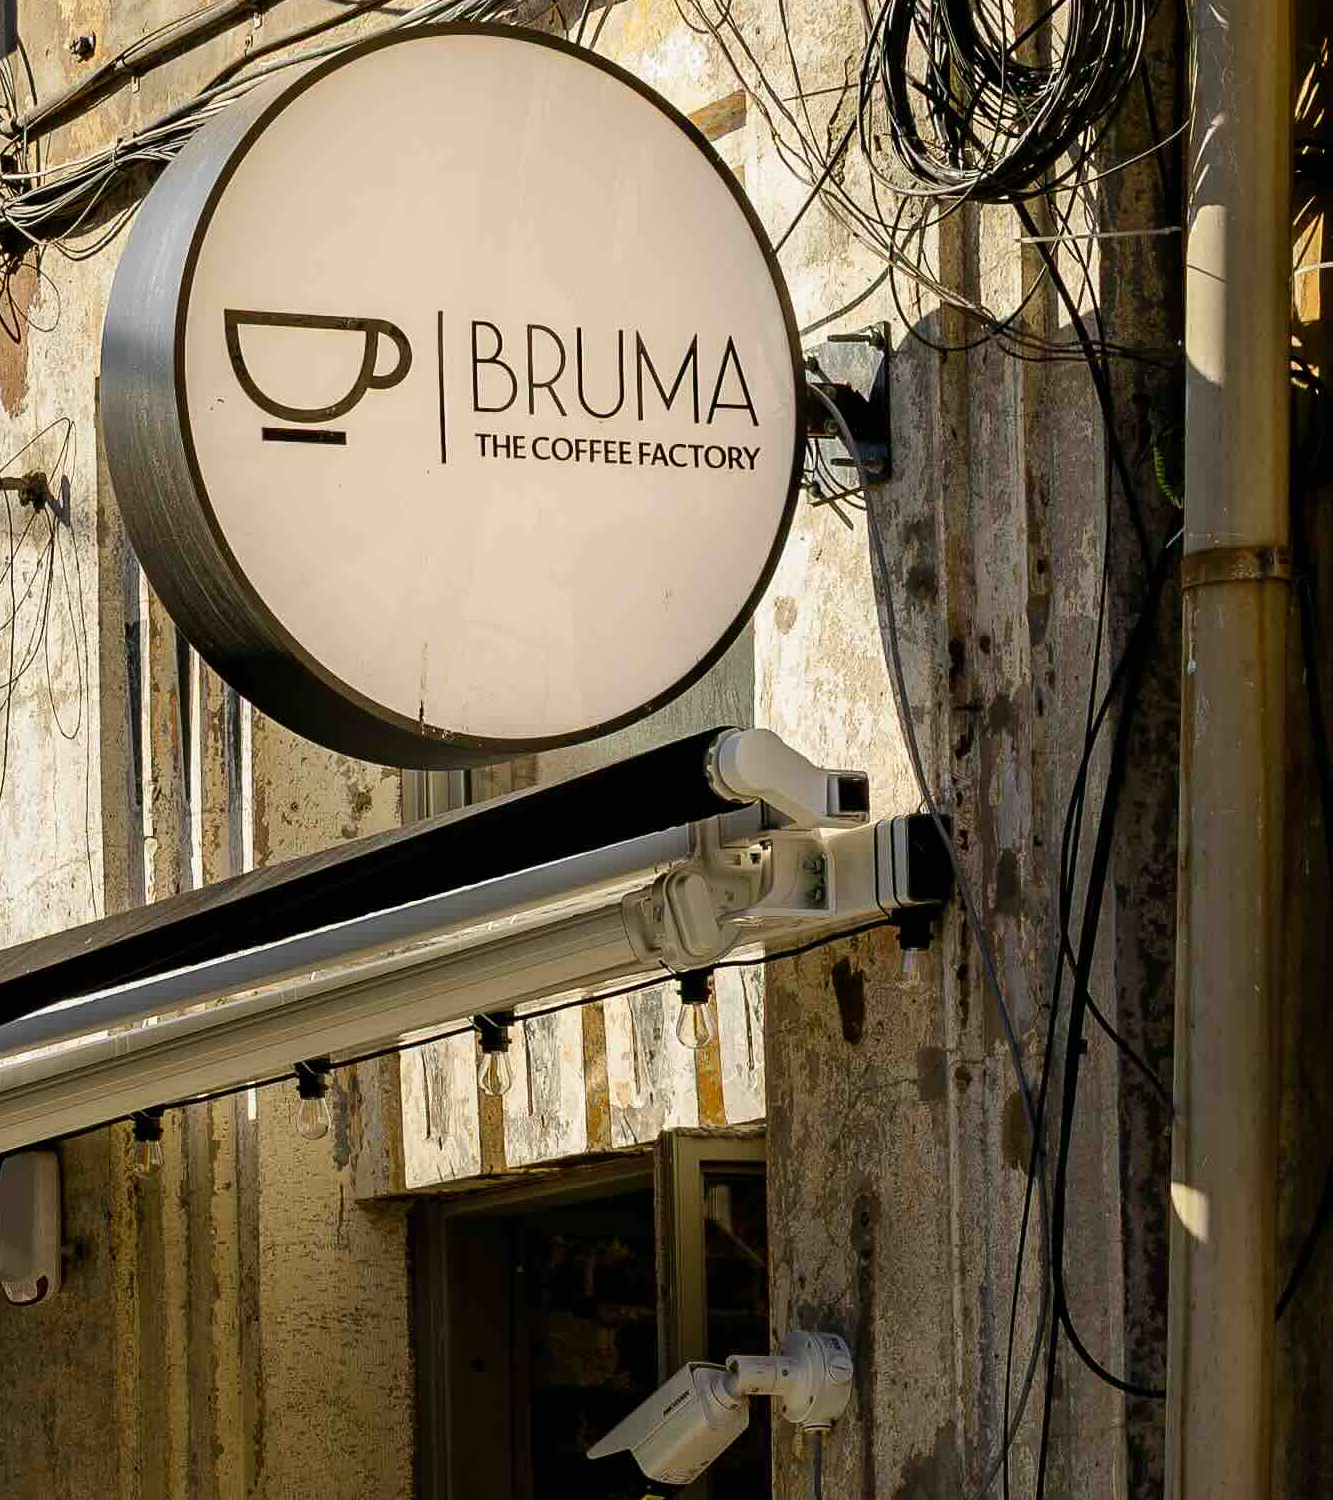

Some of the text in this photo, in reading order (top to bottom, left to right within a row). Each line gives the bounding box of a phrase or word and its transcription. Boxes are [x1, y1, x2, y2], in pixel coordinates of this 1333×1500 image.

[471, 320, 760, 427] BRUMA
[474, 433, 761, 471] THE COFFEE FACTORY
